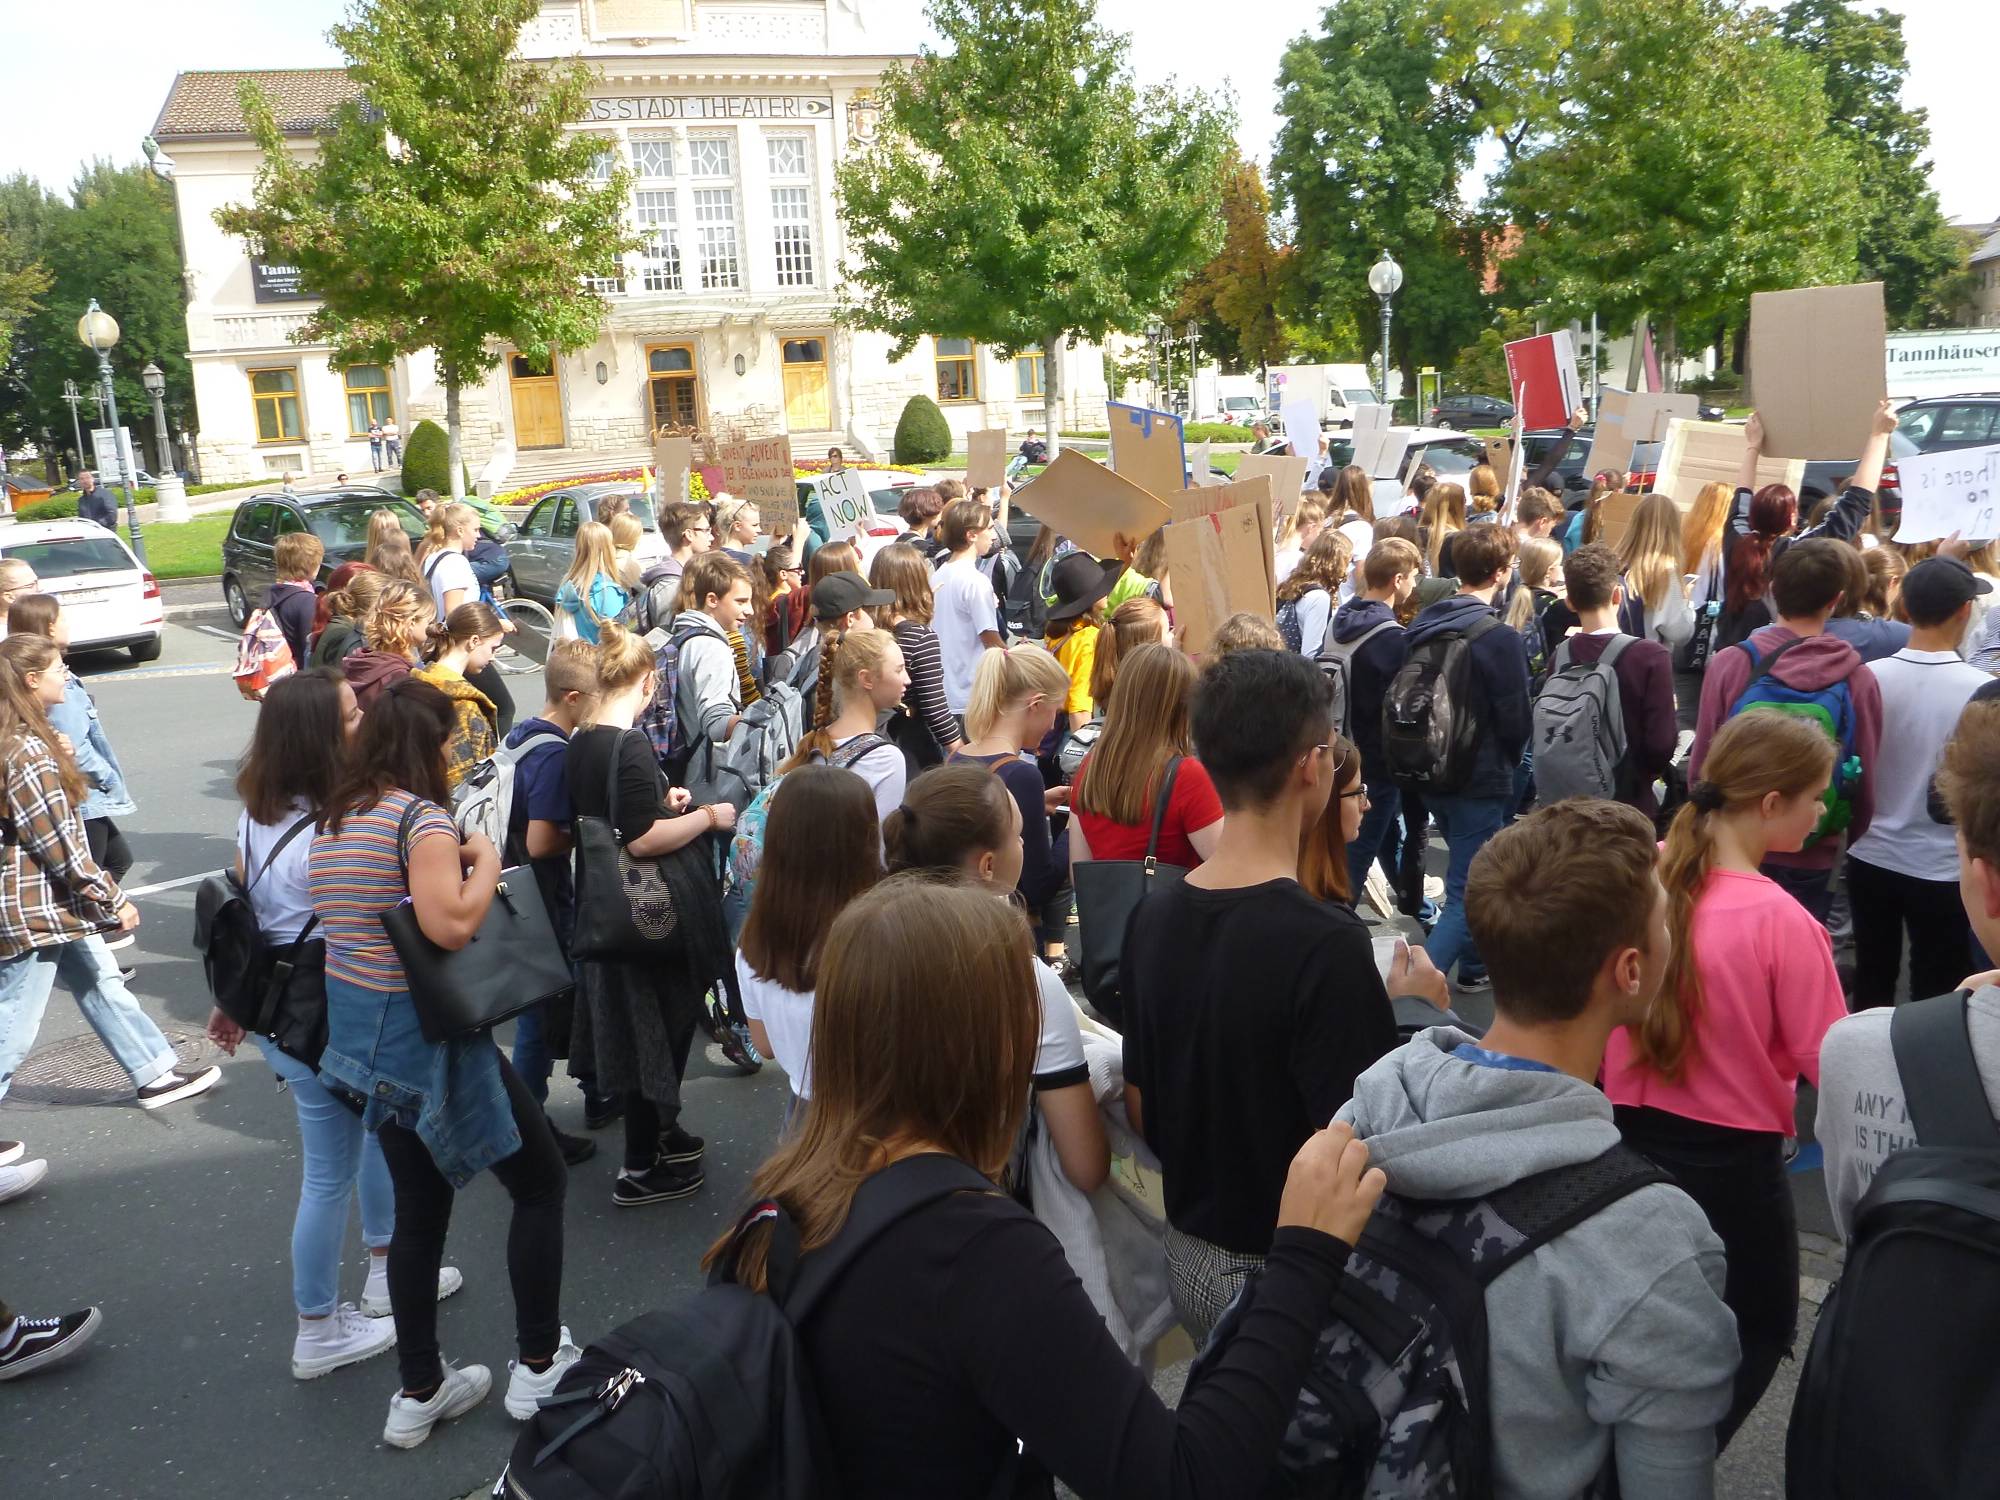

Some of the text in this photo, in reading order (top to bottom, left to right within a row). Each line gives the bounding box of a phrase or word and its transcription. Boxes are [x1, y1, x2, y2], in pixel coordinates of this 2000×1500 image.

[696, 96, 798, 118] THEATER
[1887, 344, 2000, 362] Tannhäuser
[820, 472, 848, 500] ACT
[830, 495, 867, 528] NOW
[1854, 1091, 1894, 1119] ANY
[1855, 1125, 1868, 1149] IS
